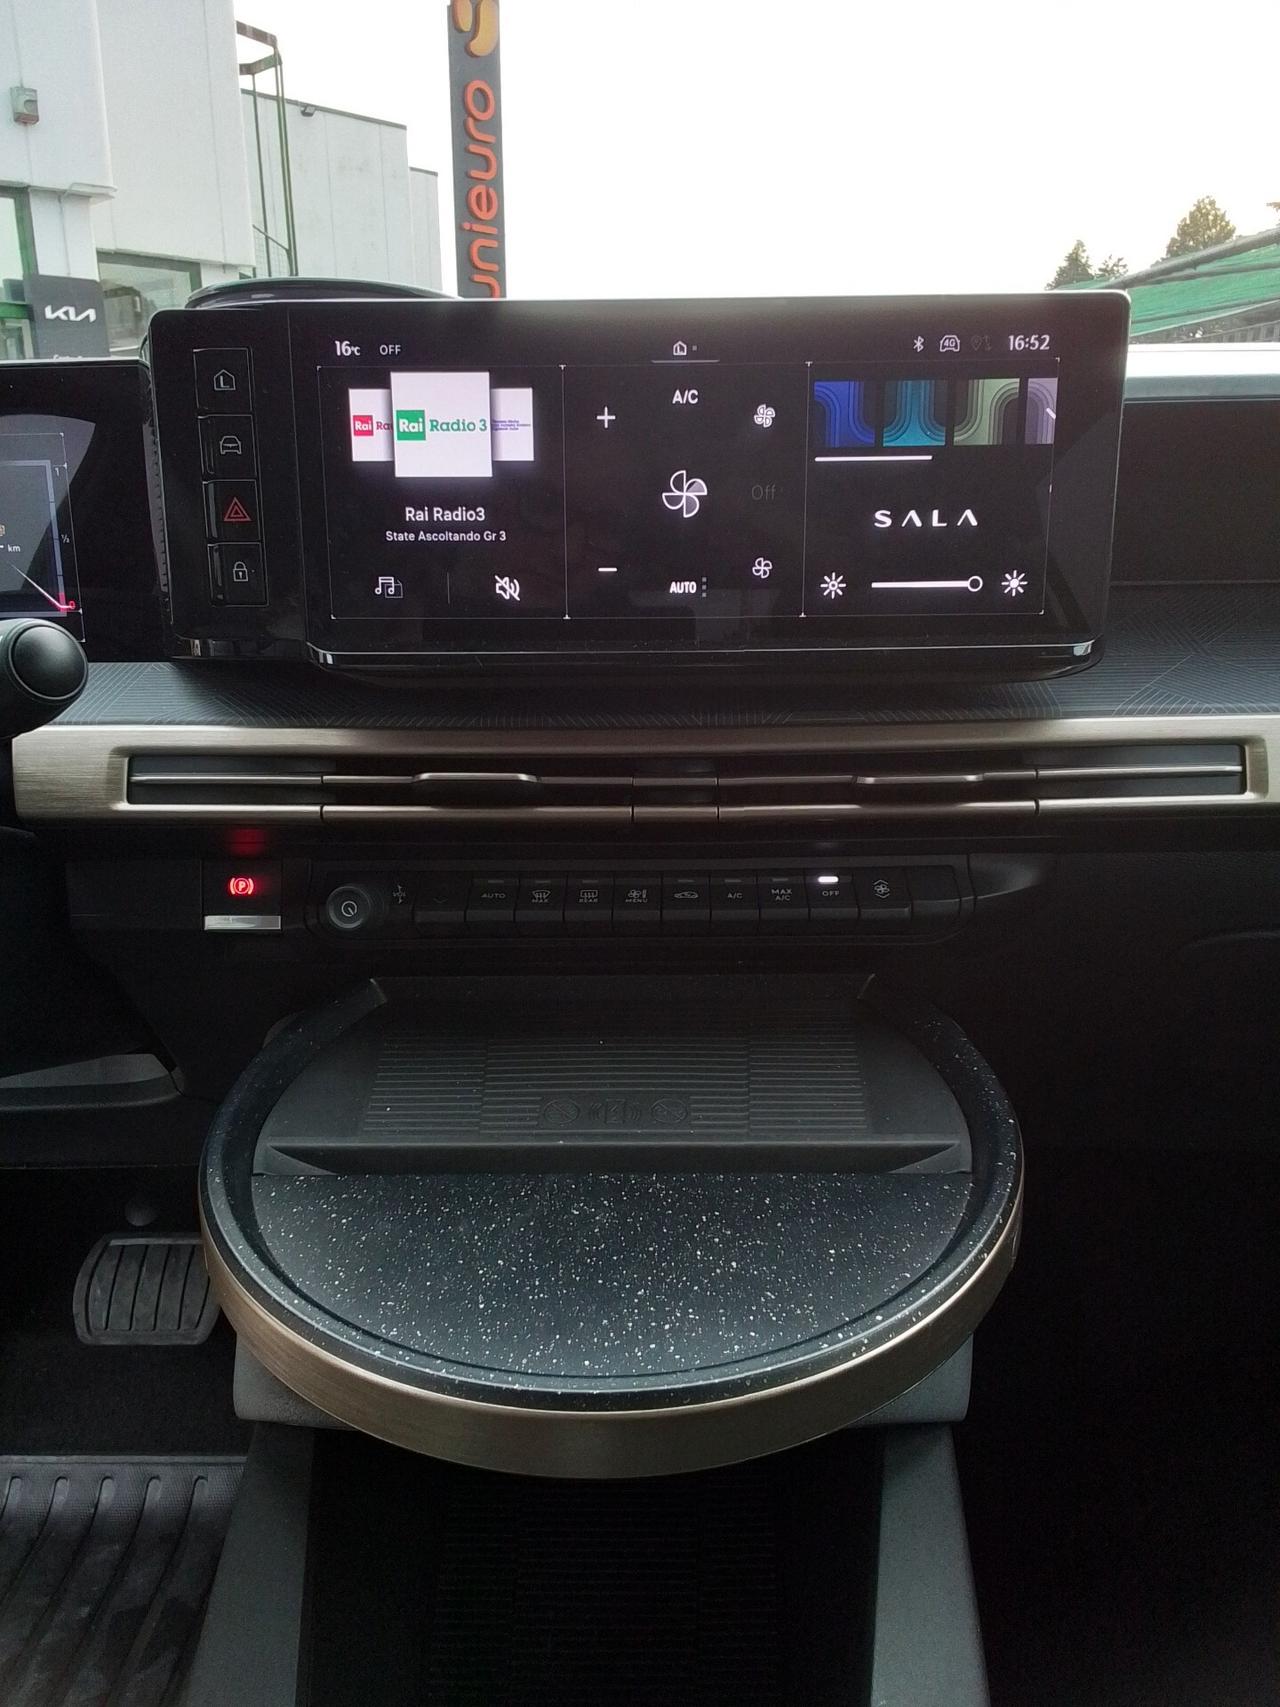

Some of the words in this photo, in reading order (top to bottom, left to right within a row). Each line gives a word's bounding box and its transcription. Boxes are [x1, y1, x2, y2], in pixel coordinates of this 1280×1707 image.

[461, 79, 501, 299] unieuro
[379, 344, 401, 355] OFF
[1008, 335, 1050, 351] 16:52
[672, 390, 699, 404] A/C
[354, 420, 373, 432] Rai
[399, 418, 423, 432] Rai
[429, 419, 476, 432] Radio
[479, 419, 487, 432] 3
[751, 484, 776, 500] Off
[405, 507, 429, 521] Rai
[433, 507, 486, 521] Radio3
[874, 509, 978, 528] SALA
[385, 531, 415, 541] State
[418, 531, 480, 541] Ascoltando
[483, 531, 498, 541] Gr
[499, 531, 506, 541] 3
[7, 544, 21, 552] km
[669, 582, 697, 593] AUTO
